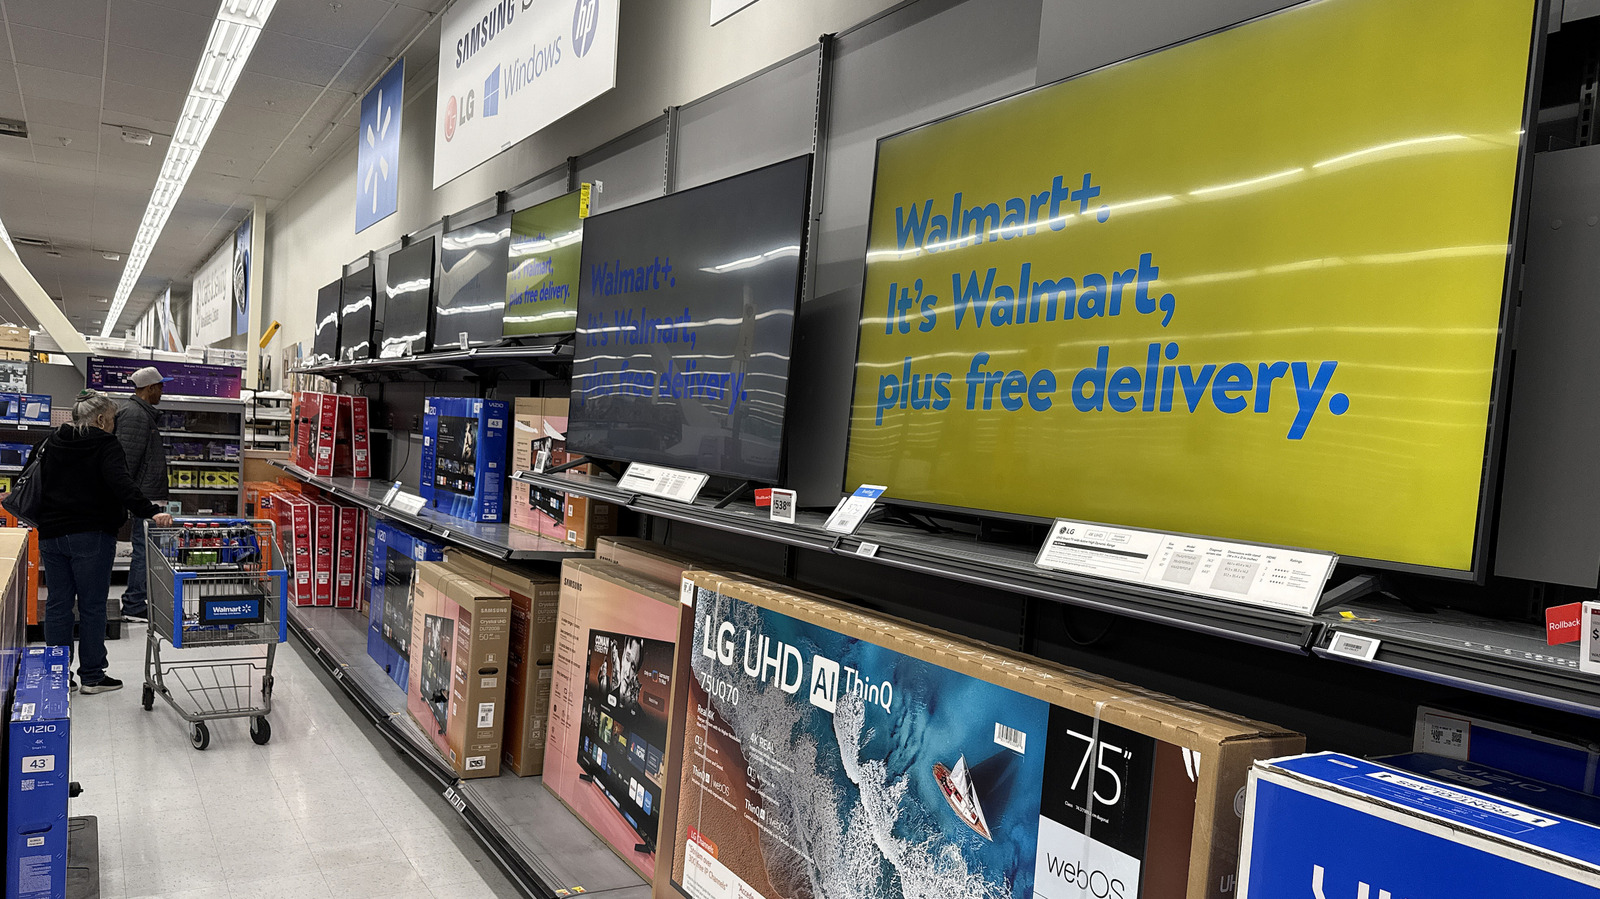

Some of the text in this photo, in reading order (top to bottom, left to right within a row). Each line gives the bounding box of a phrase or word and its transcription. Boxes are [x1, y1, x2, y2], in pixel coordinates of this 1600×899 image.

[456, 0, 515, 69] SAMSUNG
[504, 35, 562, 100] Windows
[459, 88, 475, 126] LG
[895, 172, 1111, 259] Walmart+.
[524, 284, 539, 304] free
[540, 280, 570, 304] delivery.
[591, 256, 675, 297] Walmart+.
[885, 252, 1176, 335] It's Walmart,
[614, 307, 697, 350] Walmart,
[581, 358, 748, 415] plus free delivery.
[875, 342, 1350, 440] plus free delivery.
[564, 577, 583, 591] SAMSUNG
[212, 605, 241, 613] Walmart
[1549, 617, 1581, 631] Rollback
[478, 633, 489, 641] 50
[702, 614, 736, 666] LG
[743, 629, 803, 694] UHD
[843, 665, 893, 714] ThinQ
[699, 671, 739, 706] 75UQ70
[22, 724, 56, 733] VIZIO
[1066, 728, 1133, 806] 75"
[1457, 764, 1547, 793] VIZIO
[744, 798, 760, 818] ThinQ
[690, 830, 697, 841] LG
[1047, 852, 1125, 899] webOS
